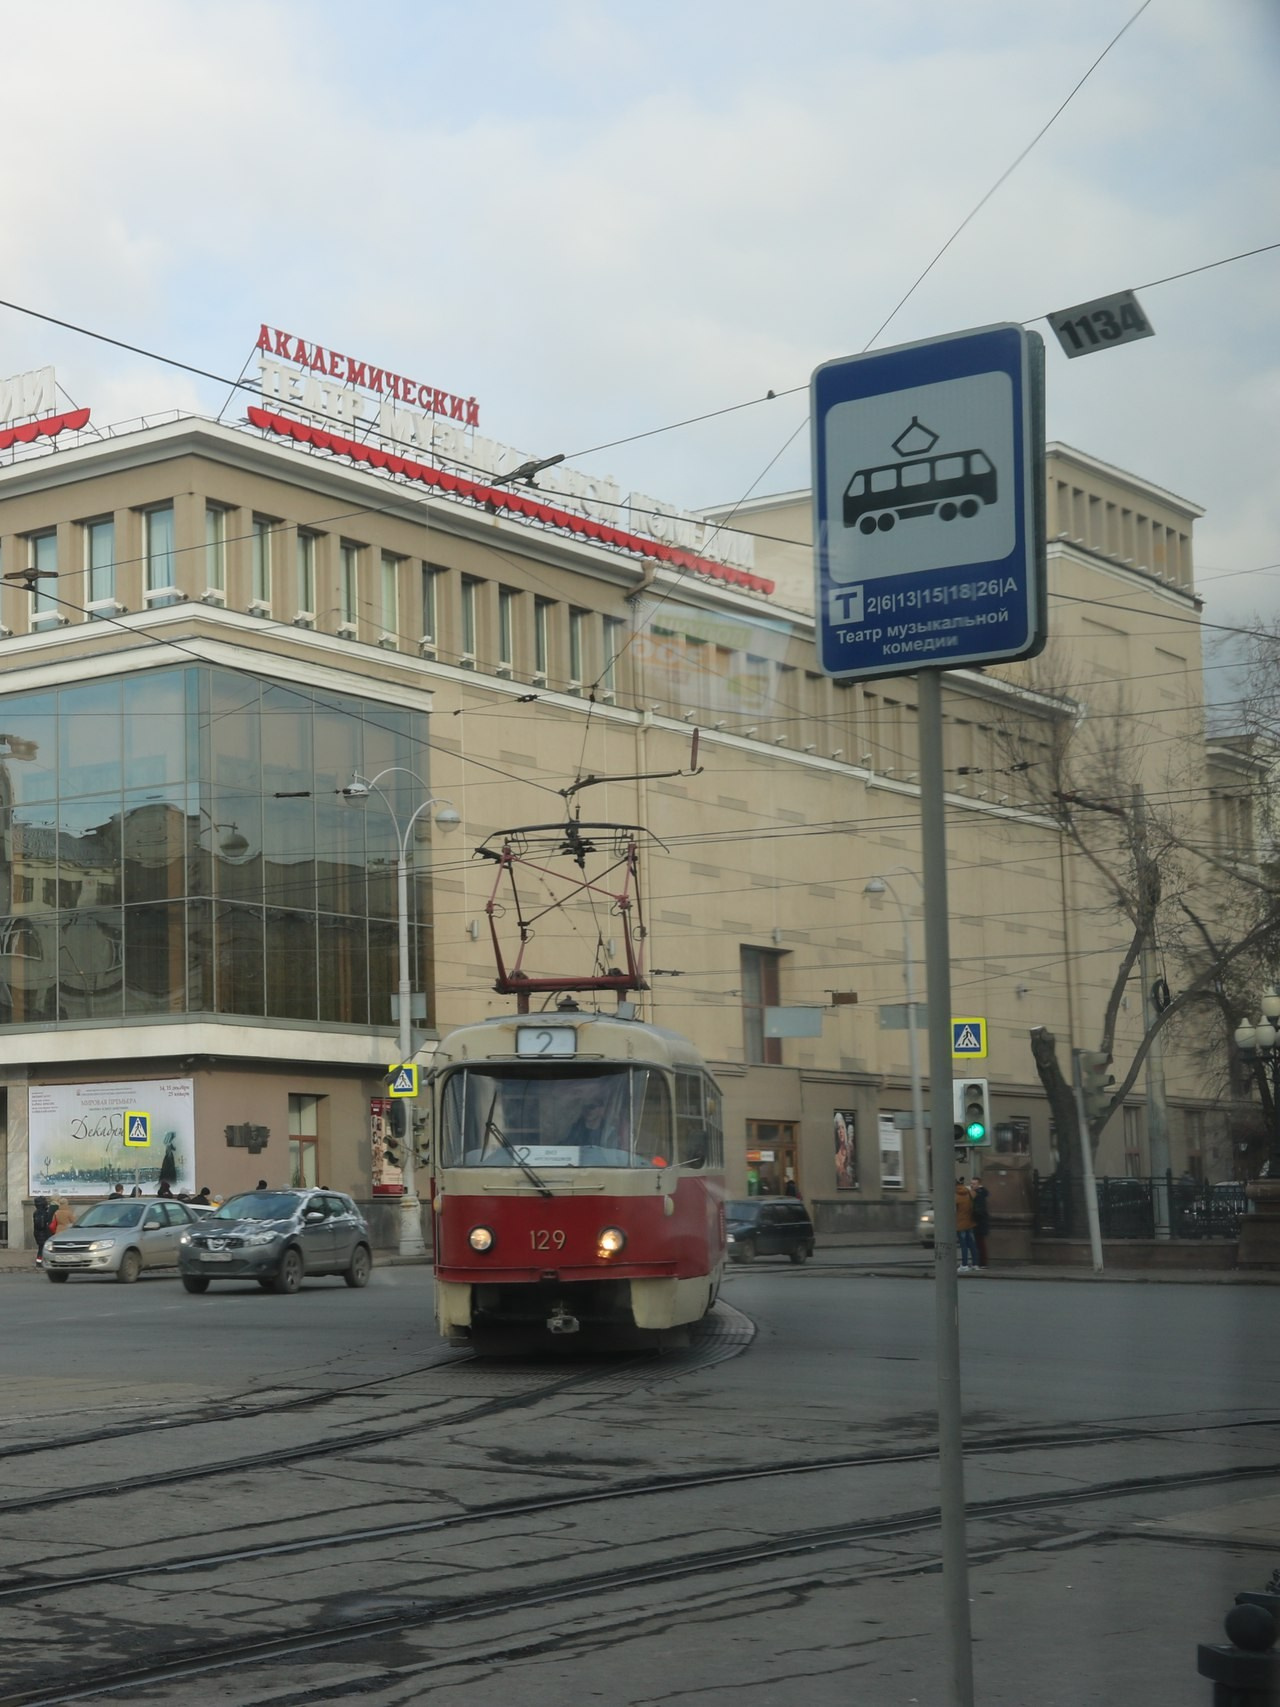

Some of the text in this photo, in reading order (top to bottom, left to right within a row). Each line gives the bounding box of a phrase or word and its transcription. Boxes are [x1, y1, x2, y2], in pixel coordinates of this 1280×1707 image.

[1057, 304, 1146, 349] 1134
[255, 323, 480, 428] АКАДЕМИЧЕСКИЙ
[258, 356, 365, 433] ТЕАТР
[836, 607, 1009, 644] Театр музыкальной
[883, 636, 959, 655] комедии
[535, 1031, 554, 1053] 2
[518, 1146, 531, 1166] 2
[529, 1229, 567, 1251] 129
